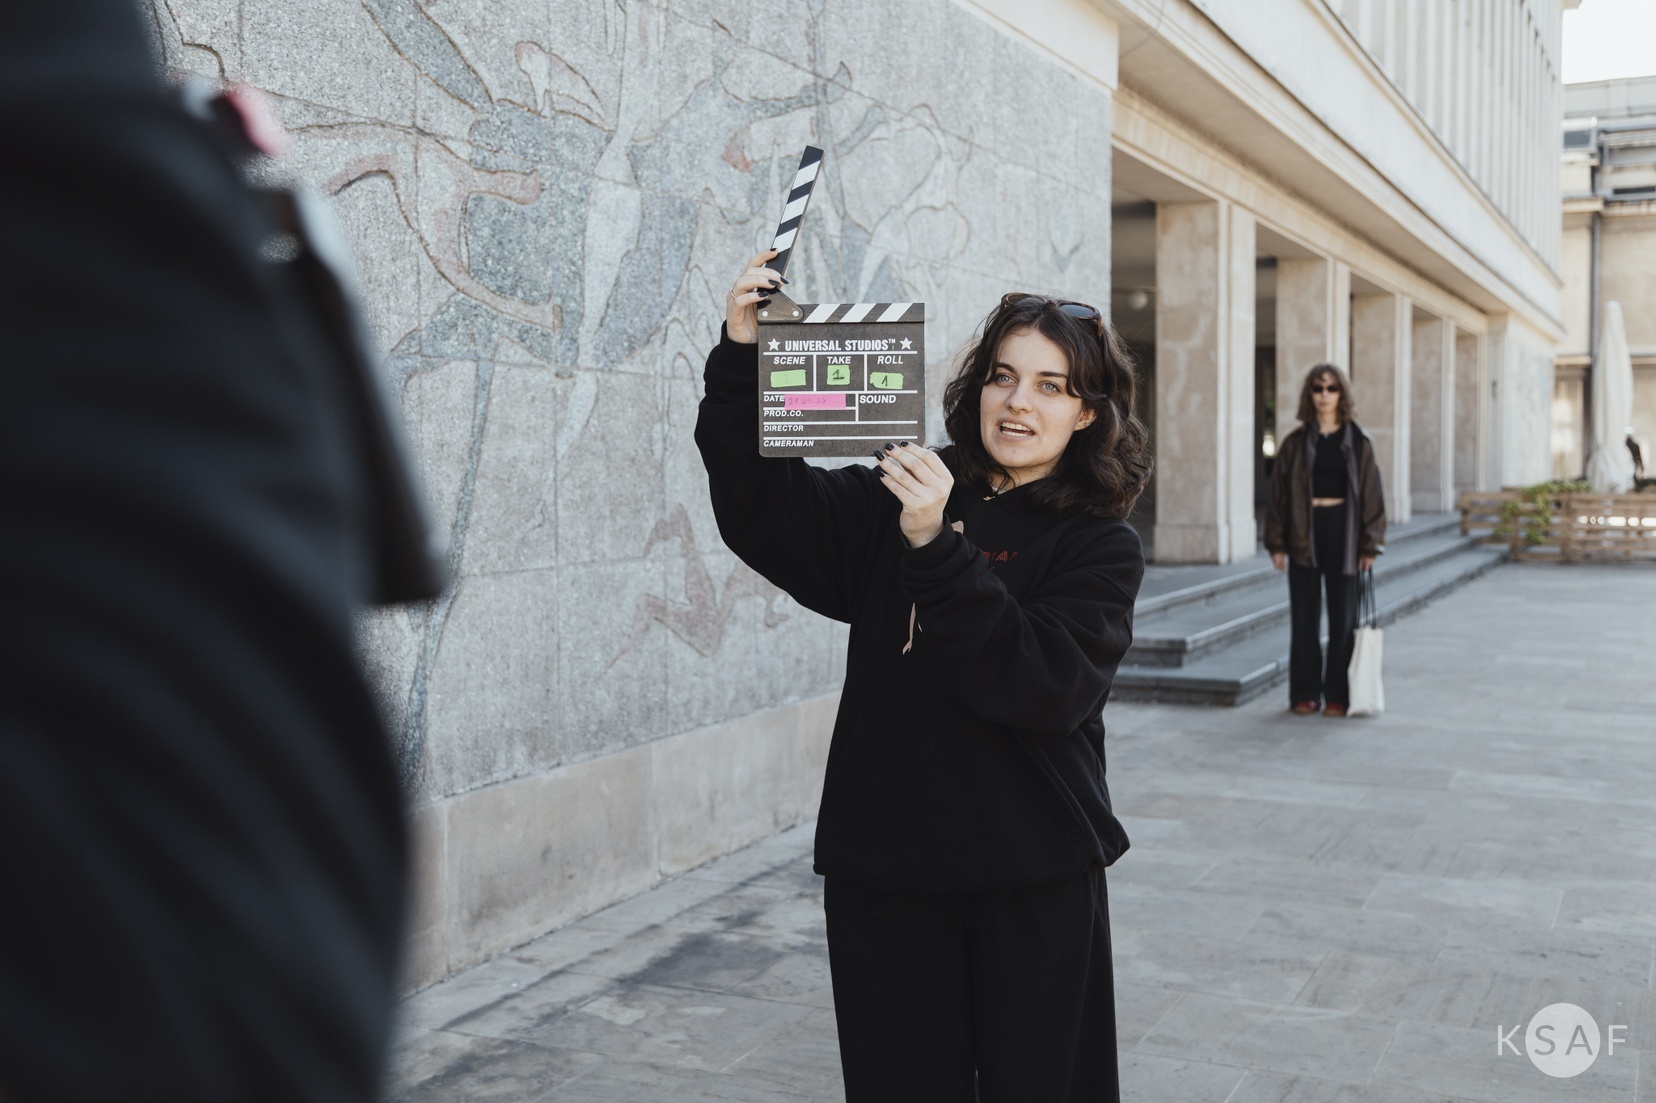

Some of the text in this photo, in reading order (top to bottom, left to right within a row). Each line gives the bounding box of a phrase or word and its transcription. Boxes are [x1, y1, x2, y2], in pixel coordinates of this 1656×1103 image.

[784, 339, 842, 351] UNIVERSAL
[773, 355, 904, 365] SCENE TAKE ROLL
[832, 369, 845, 380] 1
[881, 374, 888, 387] 1
[859, 394, 897, 404] SOUND
[763, 439, 815, 447] CAMERAMAN
